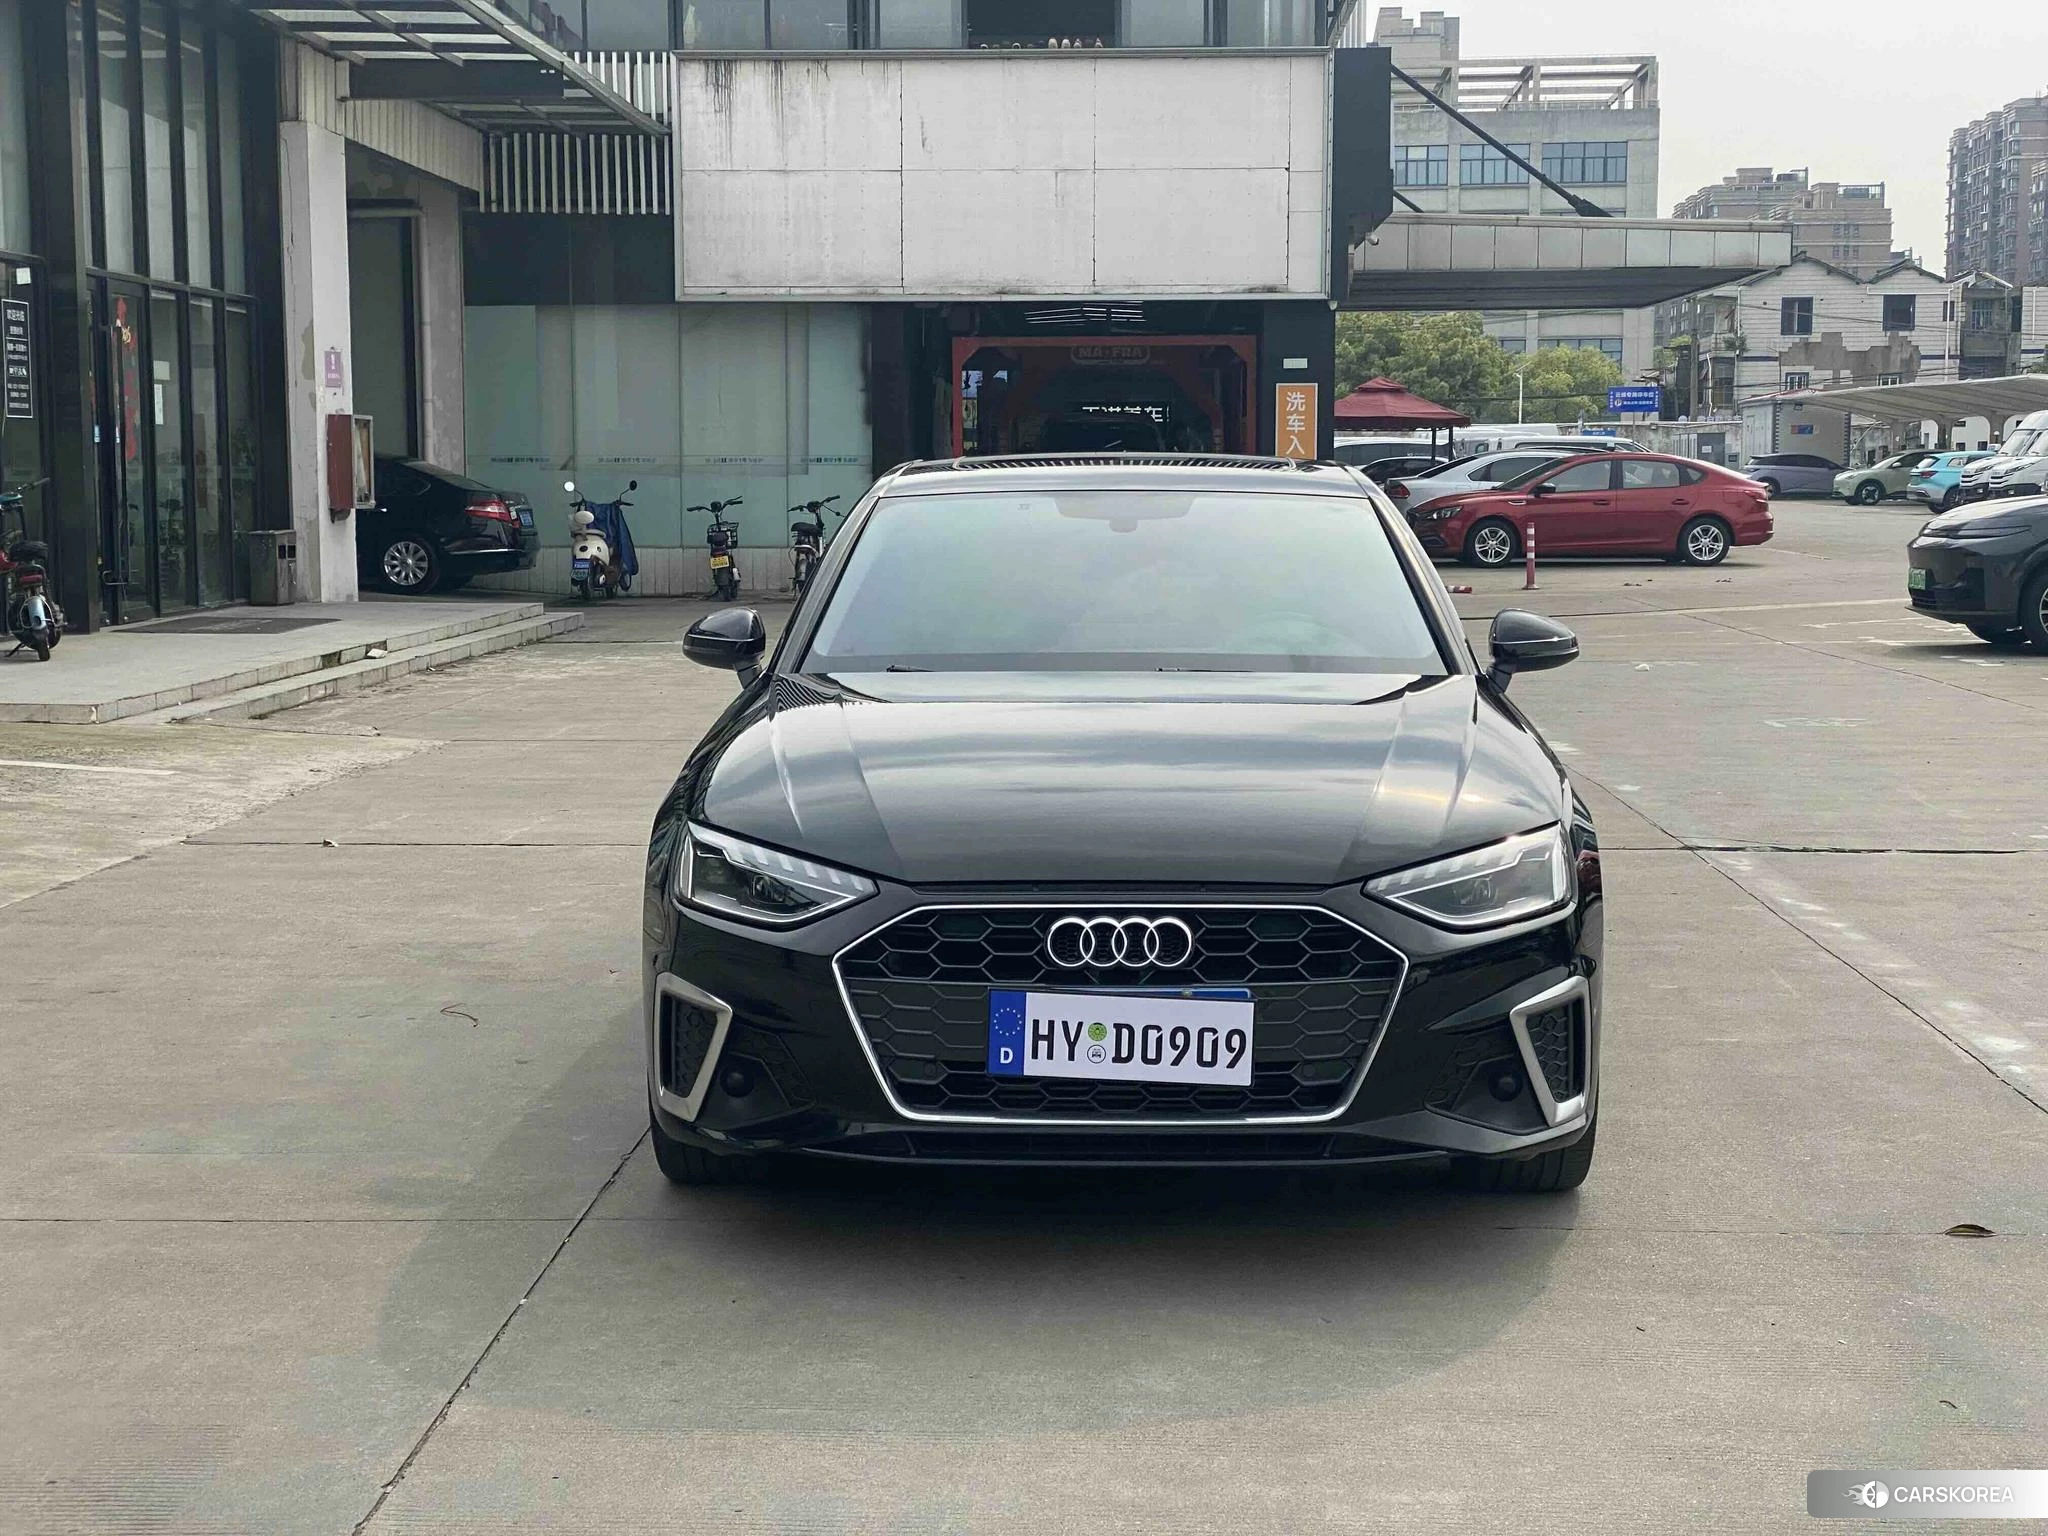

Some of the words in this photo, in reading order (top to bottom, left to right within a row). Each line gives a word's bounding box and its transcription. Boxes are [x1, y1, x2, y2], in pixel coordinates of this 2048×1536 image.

[1286, 391, 1305, 455] 洗车入
[1000, 1048, 1013, 1064] D
[1031, 1019, 1084, 1061] HY
[1111, 1022, 1247, 1069] D0909
